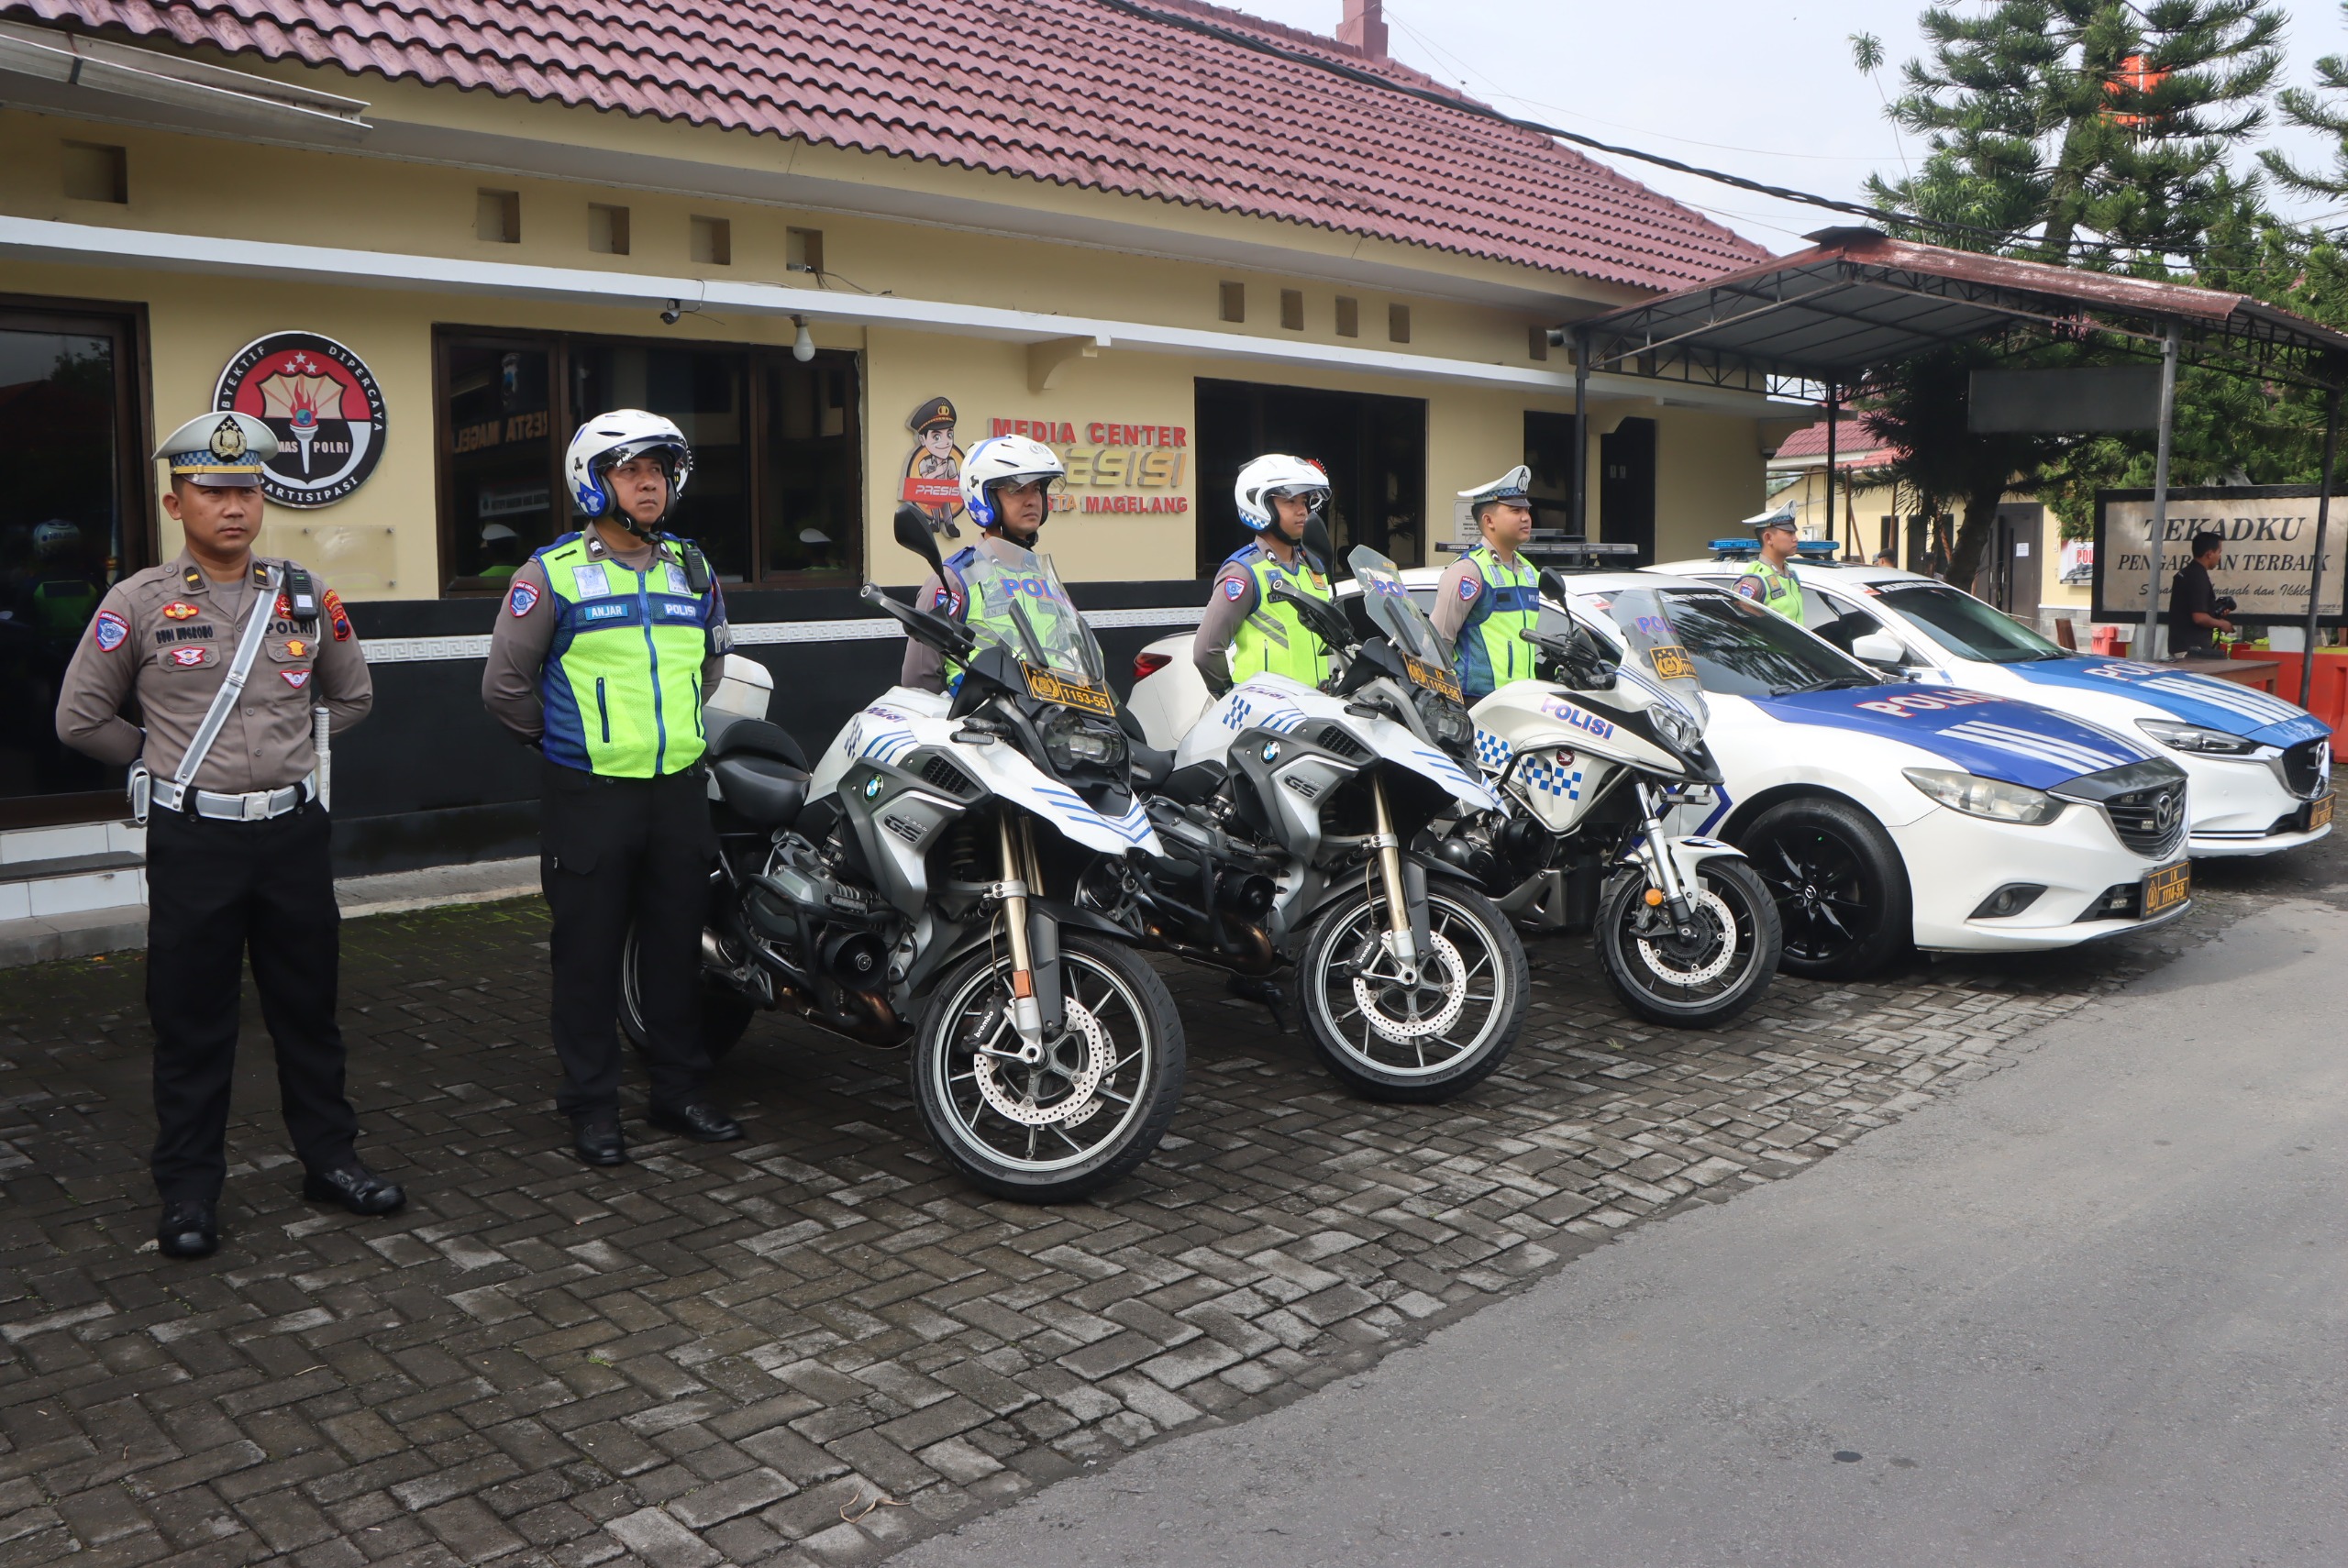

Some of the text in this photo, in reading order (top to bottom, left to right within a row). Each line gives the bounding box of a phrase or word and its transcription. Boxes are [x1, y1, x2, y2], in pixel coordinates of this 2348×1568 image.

[221, 346, 265, 408] BYEKTIF
[328, 346, 382, 431] DIPERCAYA
[992, 418, 1187, 447] MEDIA CENTER
[278, 441, 349, 453] MAS POLRI
[1055, 448, 1187, 486] ESISI
[915, 485, 960, 496] PRESIS
[1086, 496, 1188, 513] MAGELANG
[2077, 549, 2094, 564] POL
[2117, 554, 2239, 571] PENGABAN
[2212, 583, 2311, 596] manah dan Ikhla
[592, 605, 623, 617] ANJAR
[665, 604, 696, 617] POLISI
[266, 621, 313, 635] POLRI
[1434, 668, 1445, 681] IX
[1429, 679, 1459, 700] 1152-55
[1063, 688, 1108, 709] 1153-55
[1541, 697, 1614, 740] POLISI
[2170, 868, 2178, 883] IX
[1357, 941, 1374, 964] brembo
[973, 1010, 993, 1038] brembo
